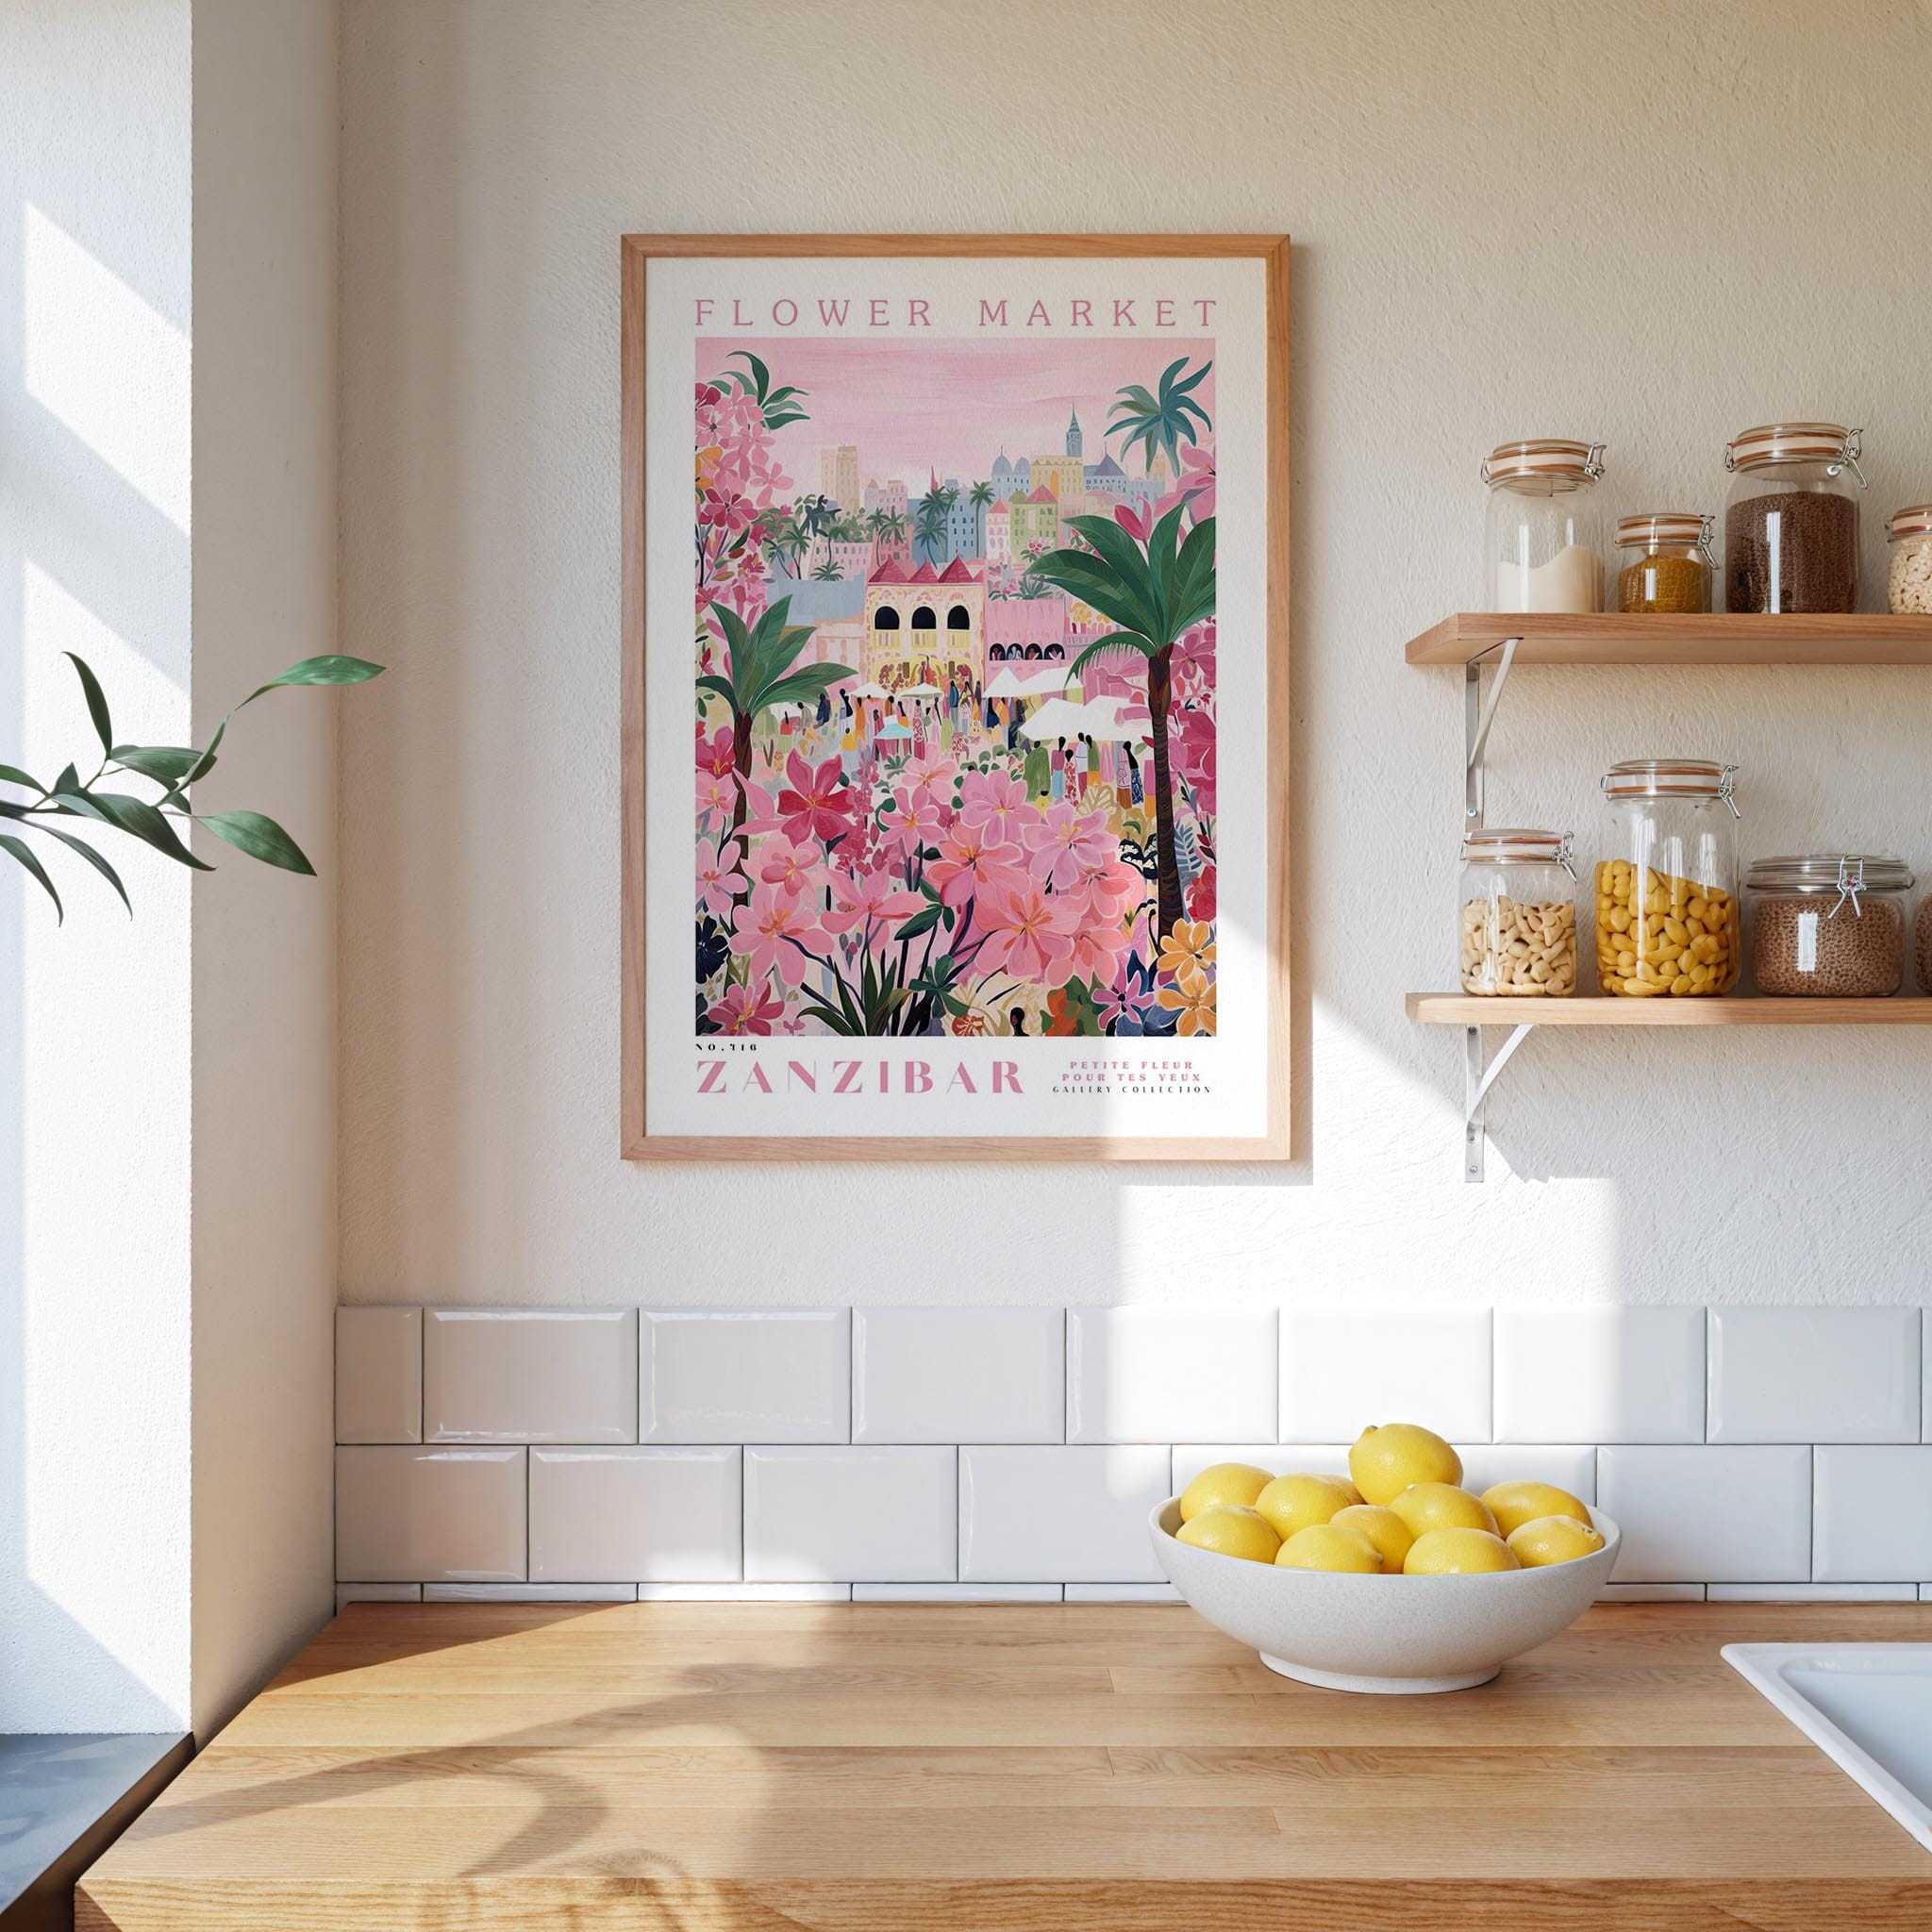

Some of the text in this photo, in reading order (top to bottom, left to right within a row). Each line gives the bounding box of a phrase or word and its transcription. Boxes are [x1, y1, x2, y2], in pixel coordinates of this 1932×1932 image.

[694, 299, 1217, 327] FLOWER MARKET
[1070, 1060, 1192, 1070] PETITE FLEUR
[696, 1060, 1024, 1094] ZANZIBAR
[1061, 1073, 1201, 1083] POUR TES YEUX
[1122, 1085, 1211, 1094] COLLECTION
